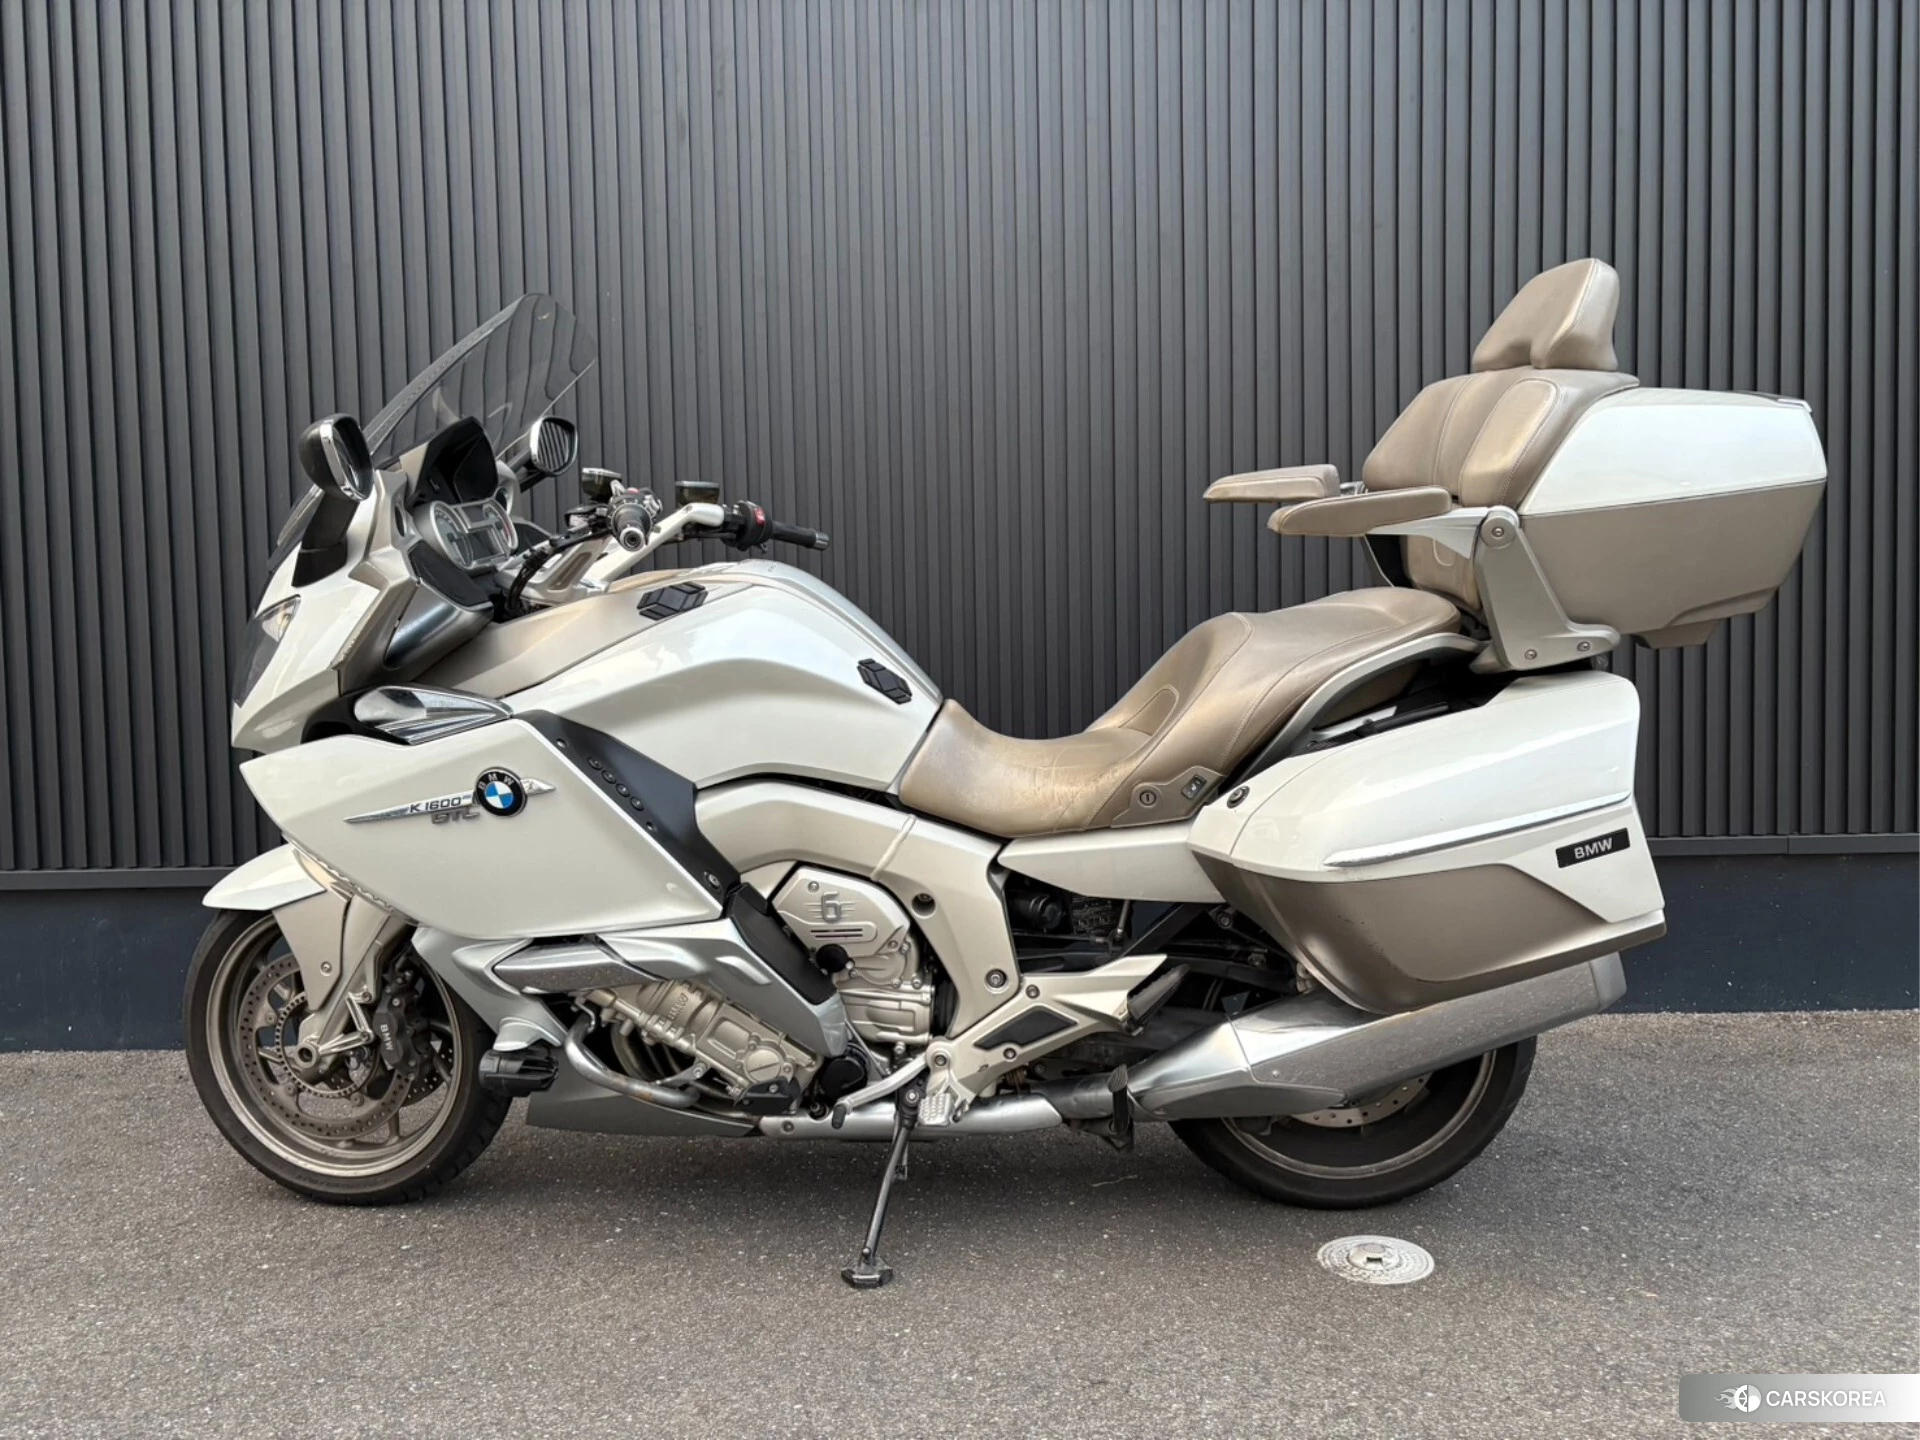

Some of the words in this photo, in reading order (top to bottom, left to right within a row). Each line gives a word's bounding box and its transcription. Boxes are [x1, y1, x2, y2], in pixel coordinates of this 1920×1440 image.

[478, 773, 515, 790] BMW
[410, 802, 421, 812] K
[425, 796, 462, 811] 1600
[431, 808, 480, 824] GTL
[1574, 837, 1613, 859] BMW
[821, 891, 842, 924] 6
[380, 1023, 394, 1050] BMW
